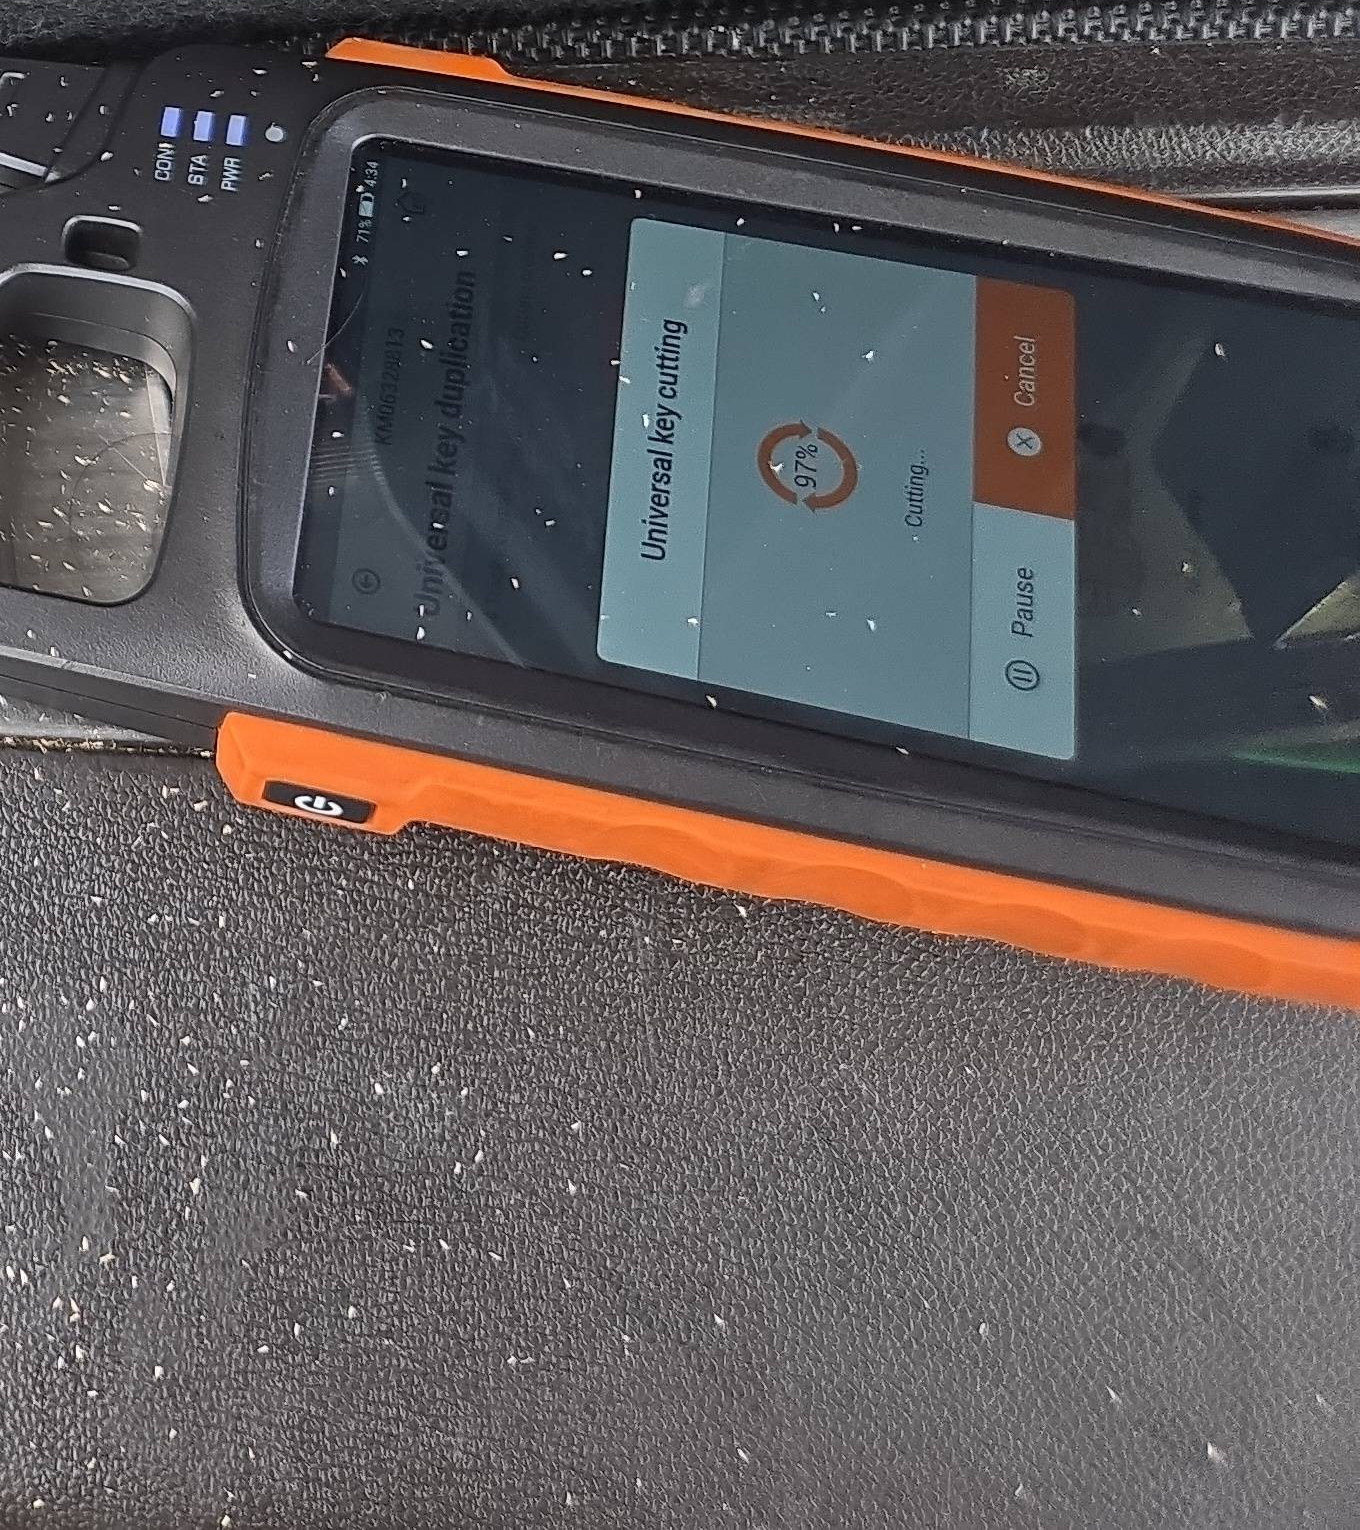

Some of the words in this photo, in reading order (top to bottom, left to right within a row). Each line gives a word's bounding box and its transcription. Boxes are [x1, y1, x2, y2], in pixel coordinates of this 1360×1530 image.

[220, 156, 242, 192] PWR
[364, 161, 379, 188] 4:34
[433, 270, 476, 419] duplication
[654, 318, 688, 401] cutting
[1012, 335, 1037, 408] Cancel
[425, 423, 467, 476] key
[647, 403, 682, 445] key
[793, 443, 818, 489] 97%
[640, 449, 673, 562] Universal
[413, 479, 453, 617] Universal
[1010, 566, 1034, 639] Pause
